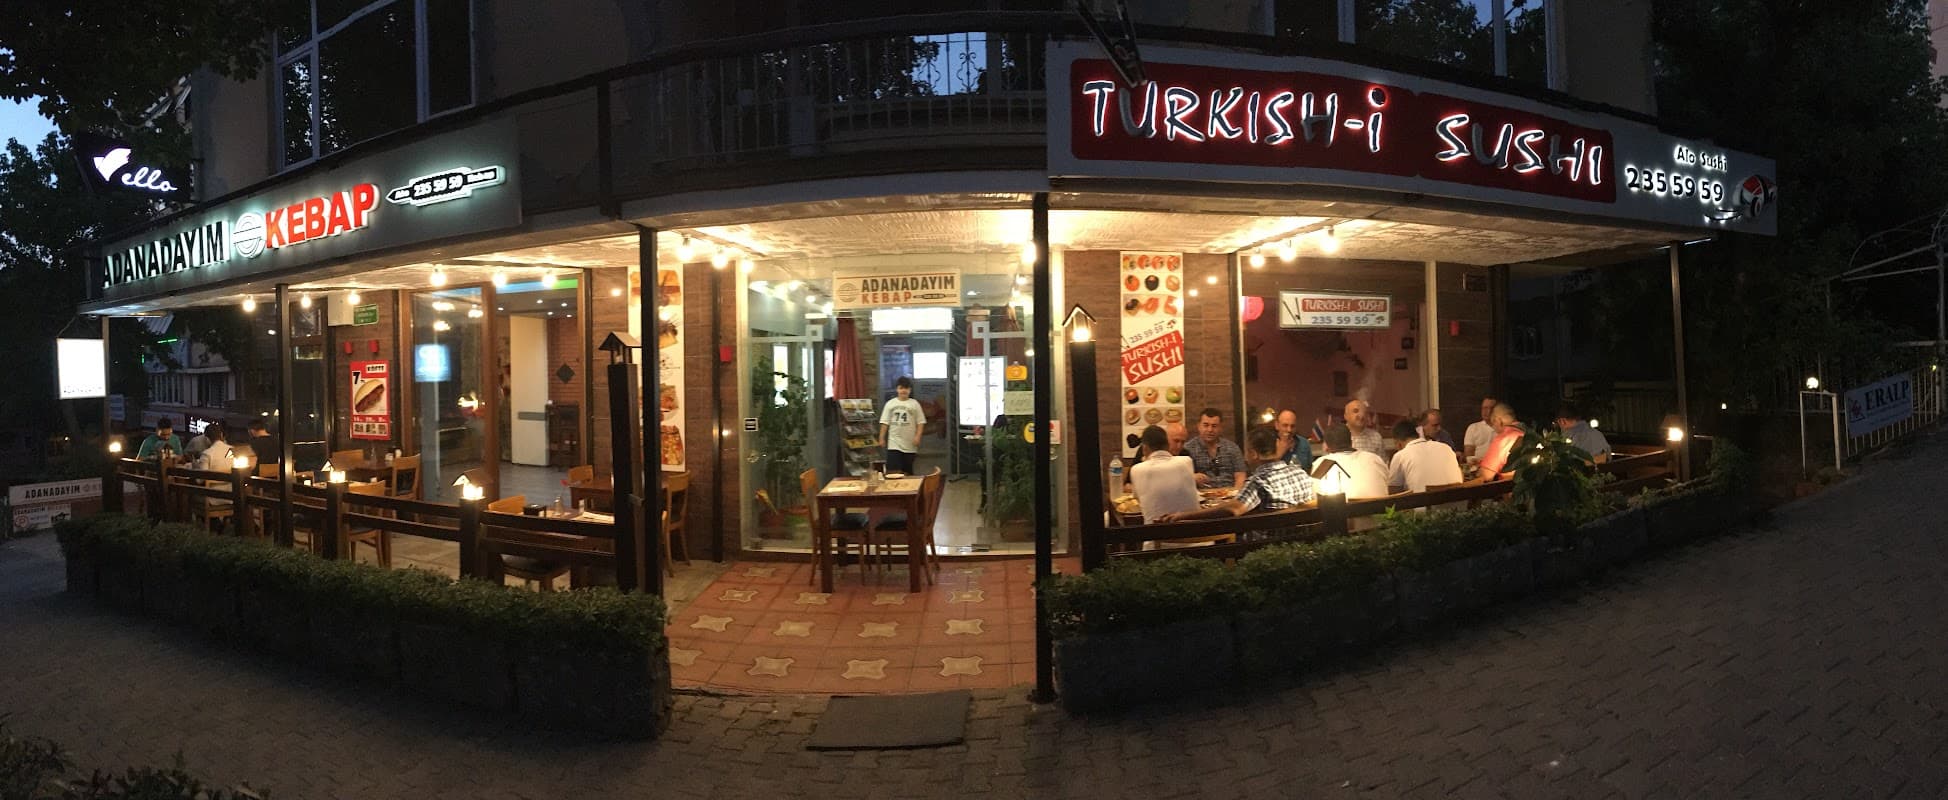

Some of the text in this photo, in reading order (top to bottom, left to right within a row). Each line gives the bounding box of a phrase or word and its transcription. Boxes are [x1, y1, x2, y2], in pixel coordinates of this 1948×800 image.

[1435, 114, 1602, 185] SUSHI
[1675, 146, 1727, 172] Alo Sushi
[413, 181, 432, 197] 235
[433, 178, 448, 193] 59
[448, 174, 463, 189] 59
[1626, 167, 1724, 202] 235 59 59
[99, 183, 378, 288] ADANADAYIM KEBAP
[861, 276, 955, 293] ADANADAYIM
[861, 291, 912, 305] KEBAP
[1357, 300, 1385, 311] SUSHI
[1311, 316, 1369, 325] 235 59 59
[1129, 324, 1164, 344] 235 59 59
[1129, 345, 1183, 382] SUSHI
[894, 412, 907, 422] 74
